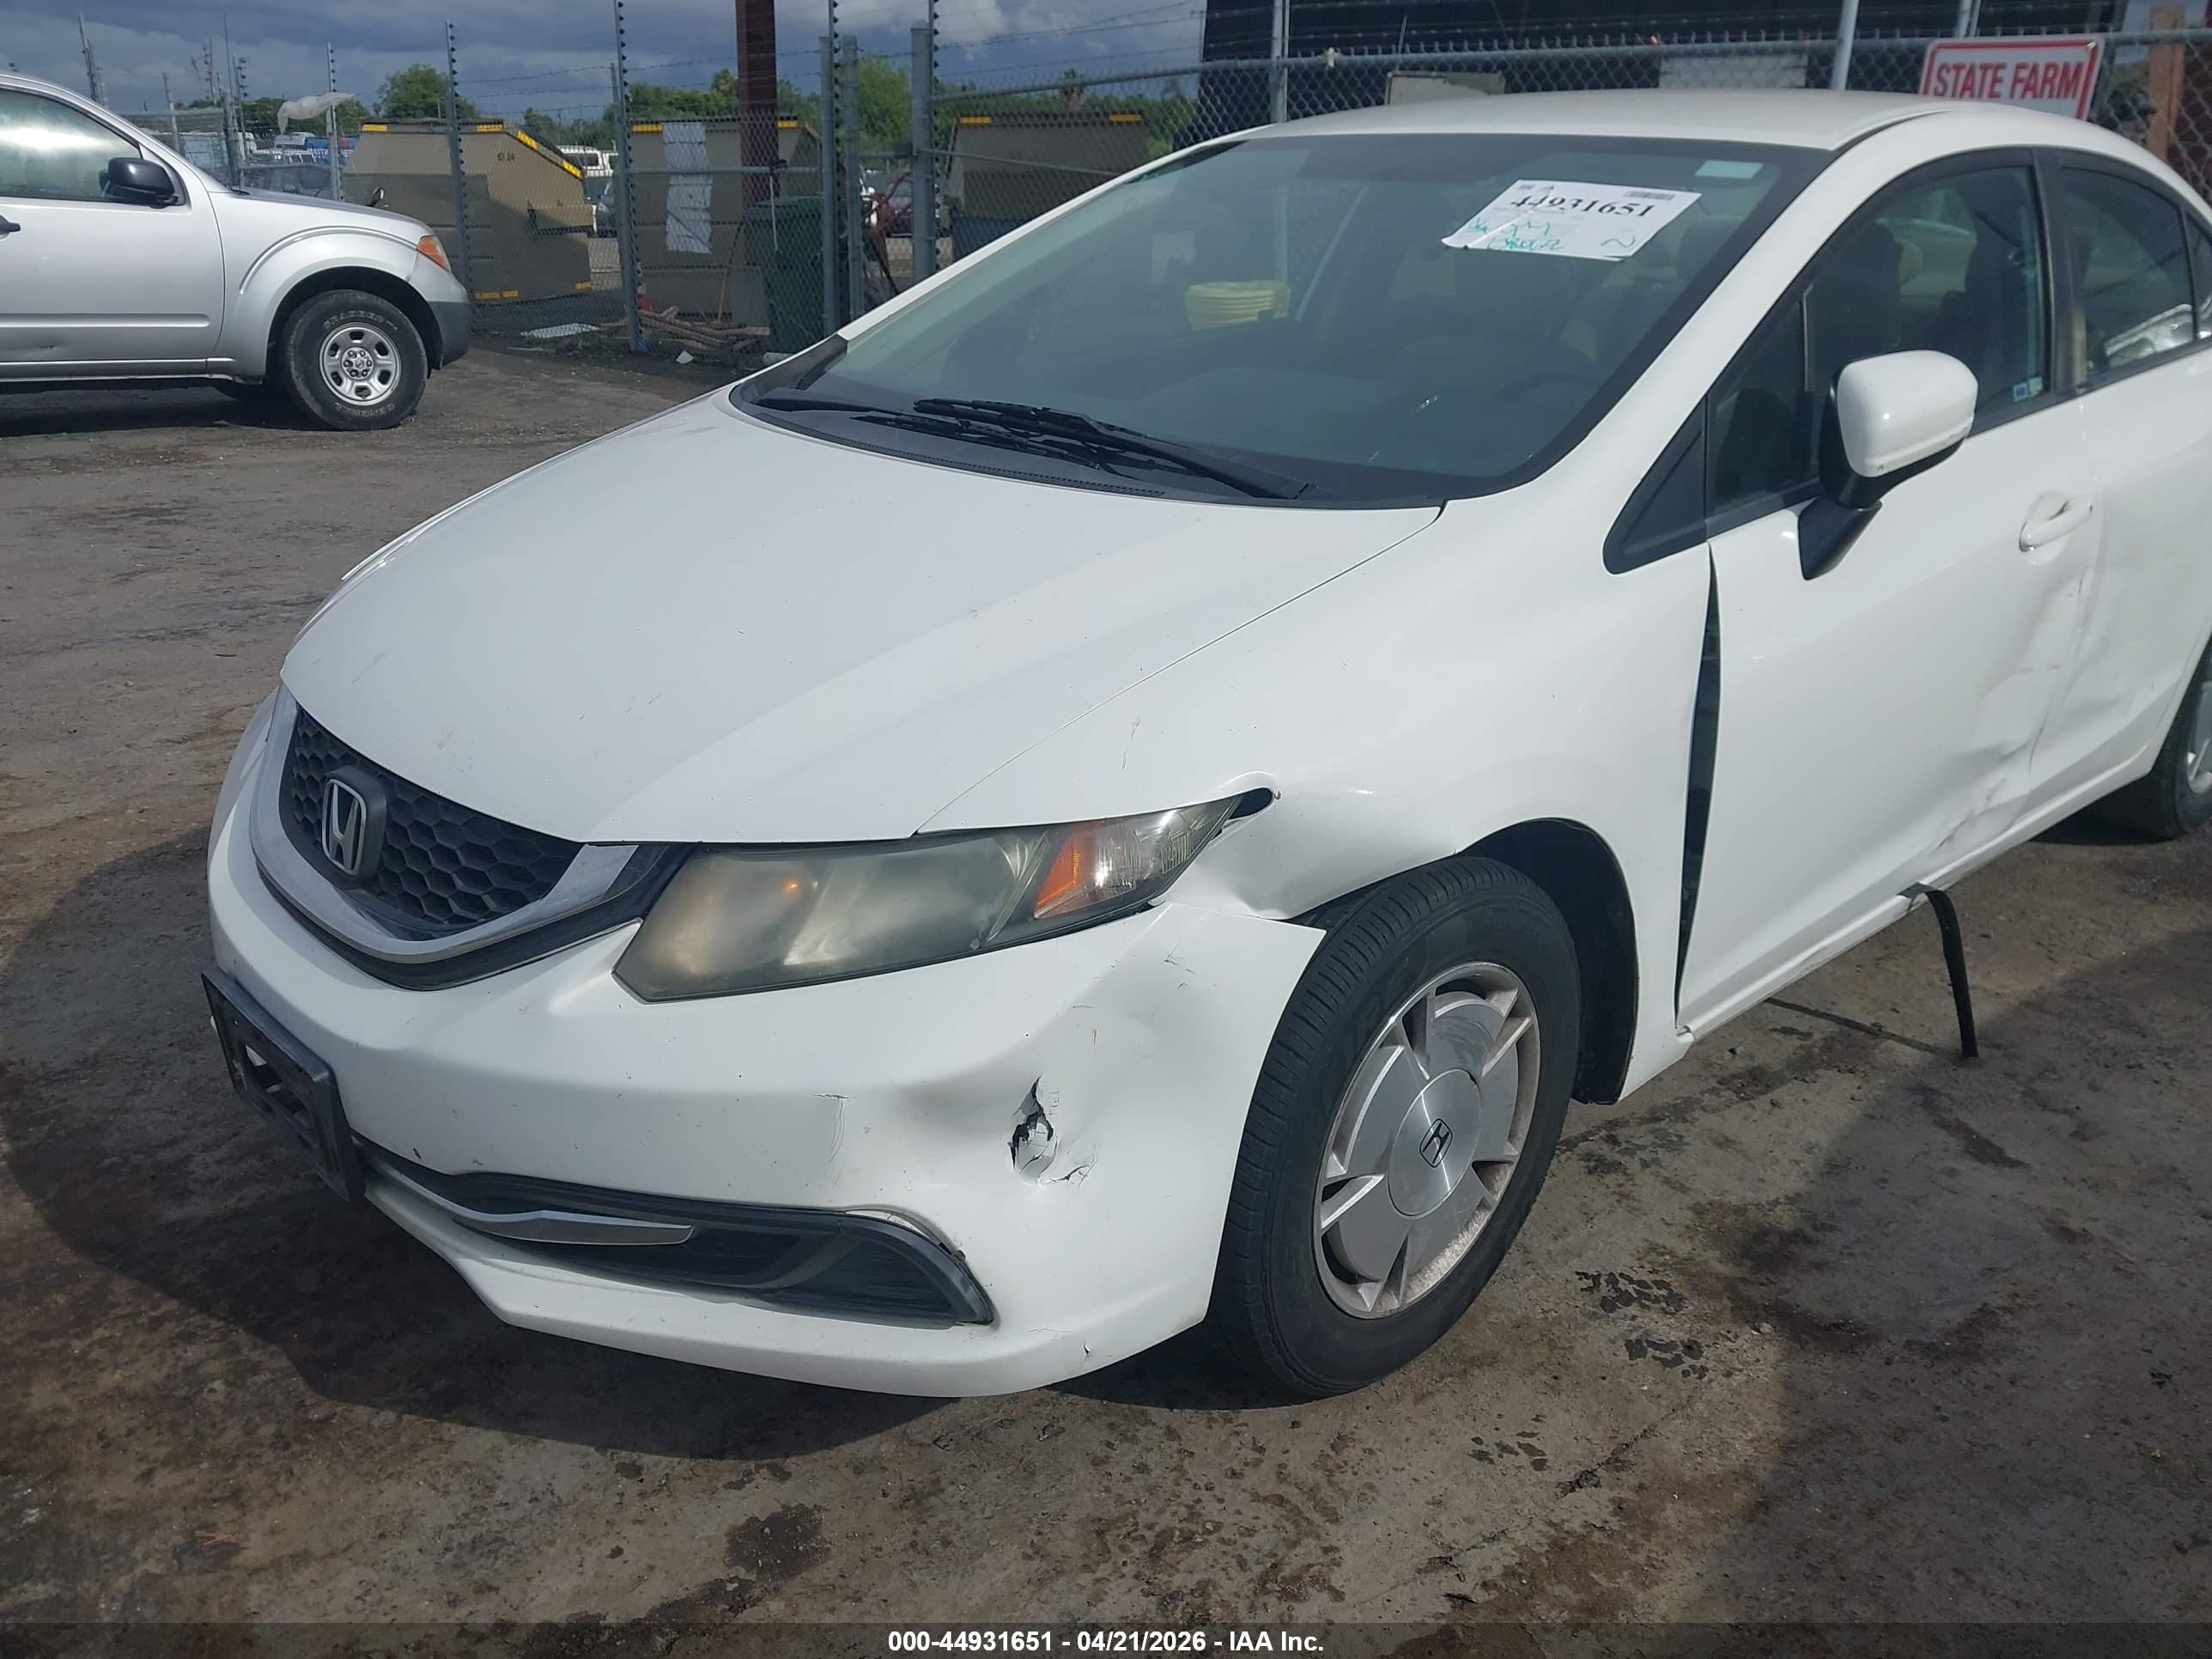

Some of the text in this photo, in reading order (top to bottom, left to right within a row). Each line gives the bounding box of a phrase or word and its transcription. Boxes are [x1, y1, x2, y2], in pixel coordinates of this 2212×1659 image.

[1933, 61, 2084, 100] STATE FARM
[1510, 195, 1655, 216] 44931651
